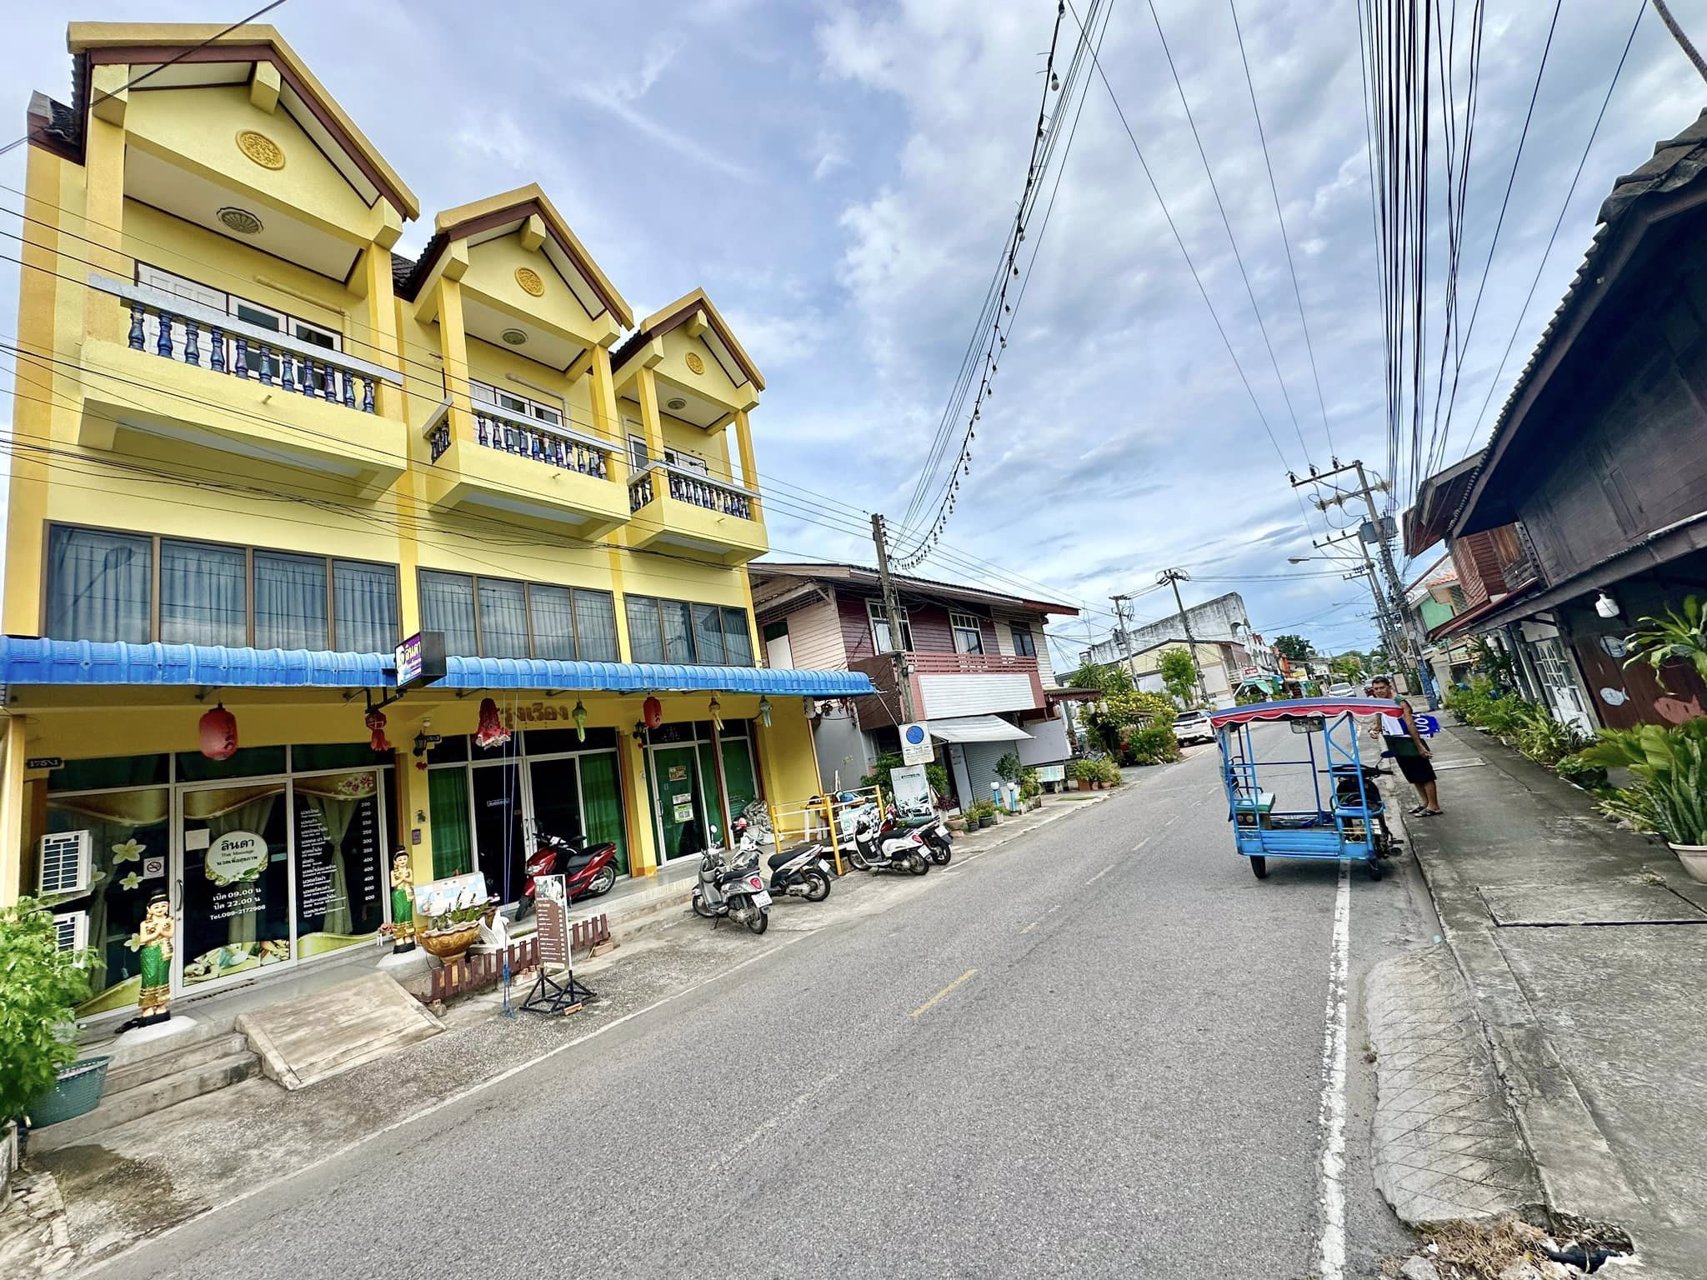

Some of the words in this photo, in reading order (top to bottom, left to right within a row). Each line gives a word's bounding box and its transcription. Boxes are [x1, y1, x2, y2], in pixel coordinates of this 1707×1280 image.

[221, 839, 255, 851] ลินดา
[227, 888, 253, 899] 09.00
[226, 897, 252, 908] 22.00
